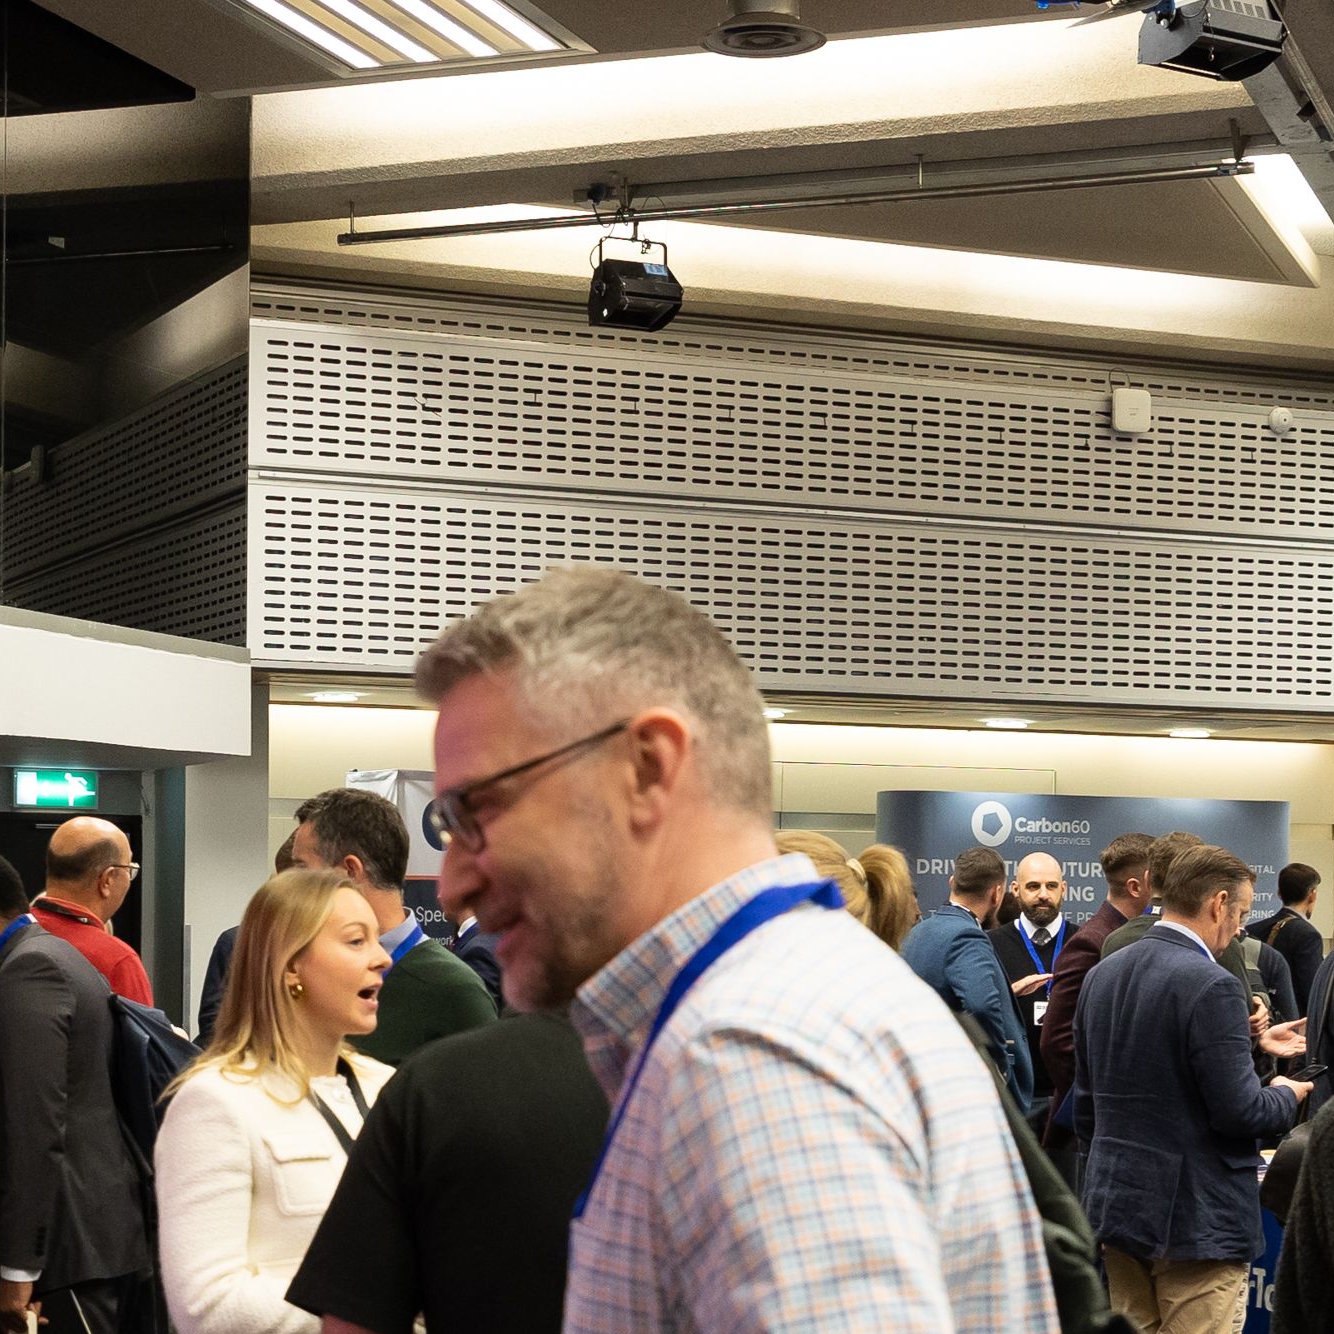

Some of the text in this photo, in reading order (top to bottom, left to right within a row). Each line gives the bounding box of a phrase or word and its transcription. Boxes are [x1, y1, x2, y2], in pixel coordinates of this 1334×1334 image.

[1014, 817, 1091, 834] Carbon60
[1014, 835, 1091, 846] PROJECT SERVICES
